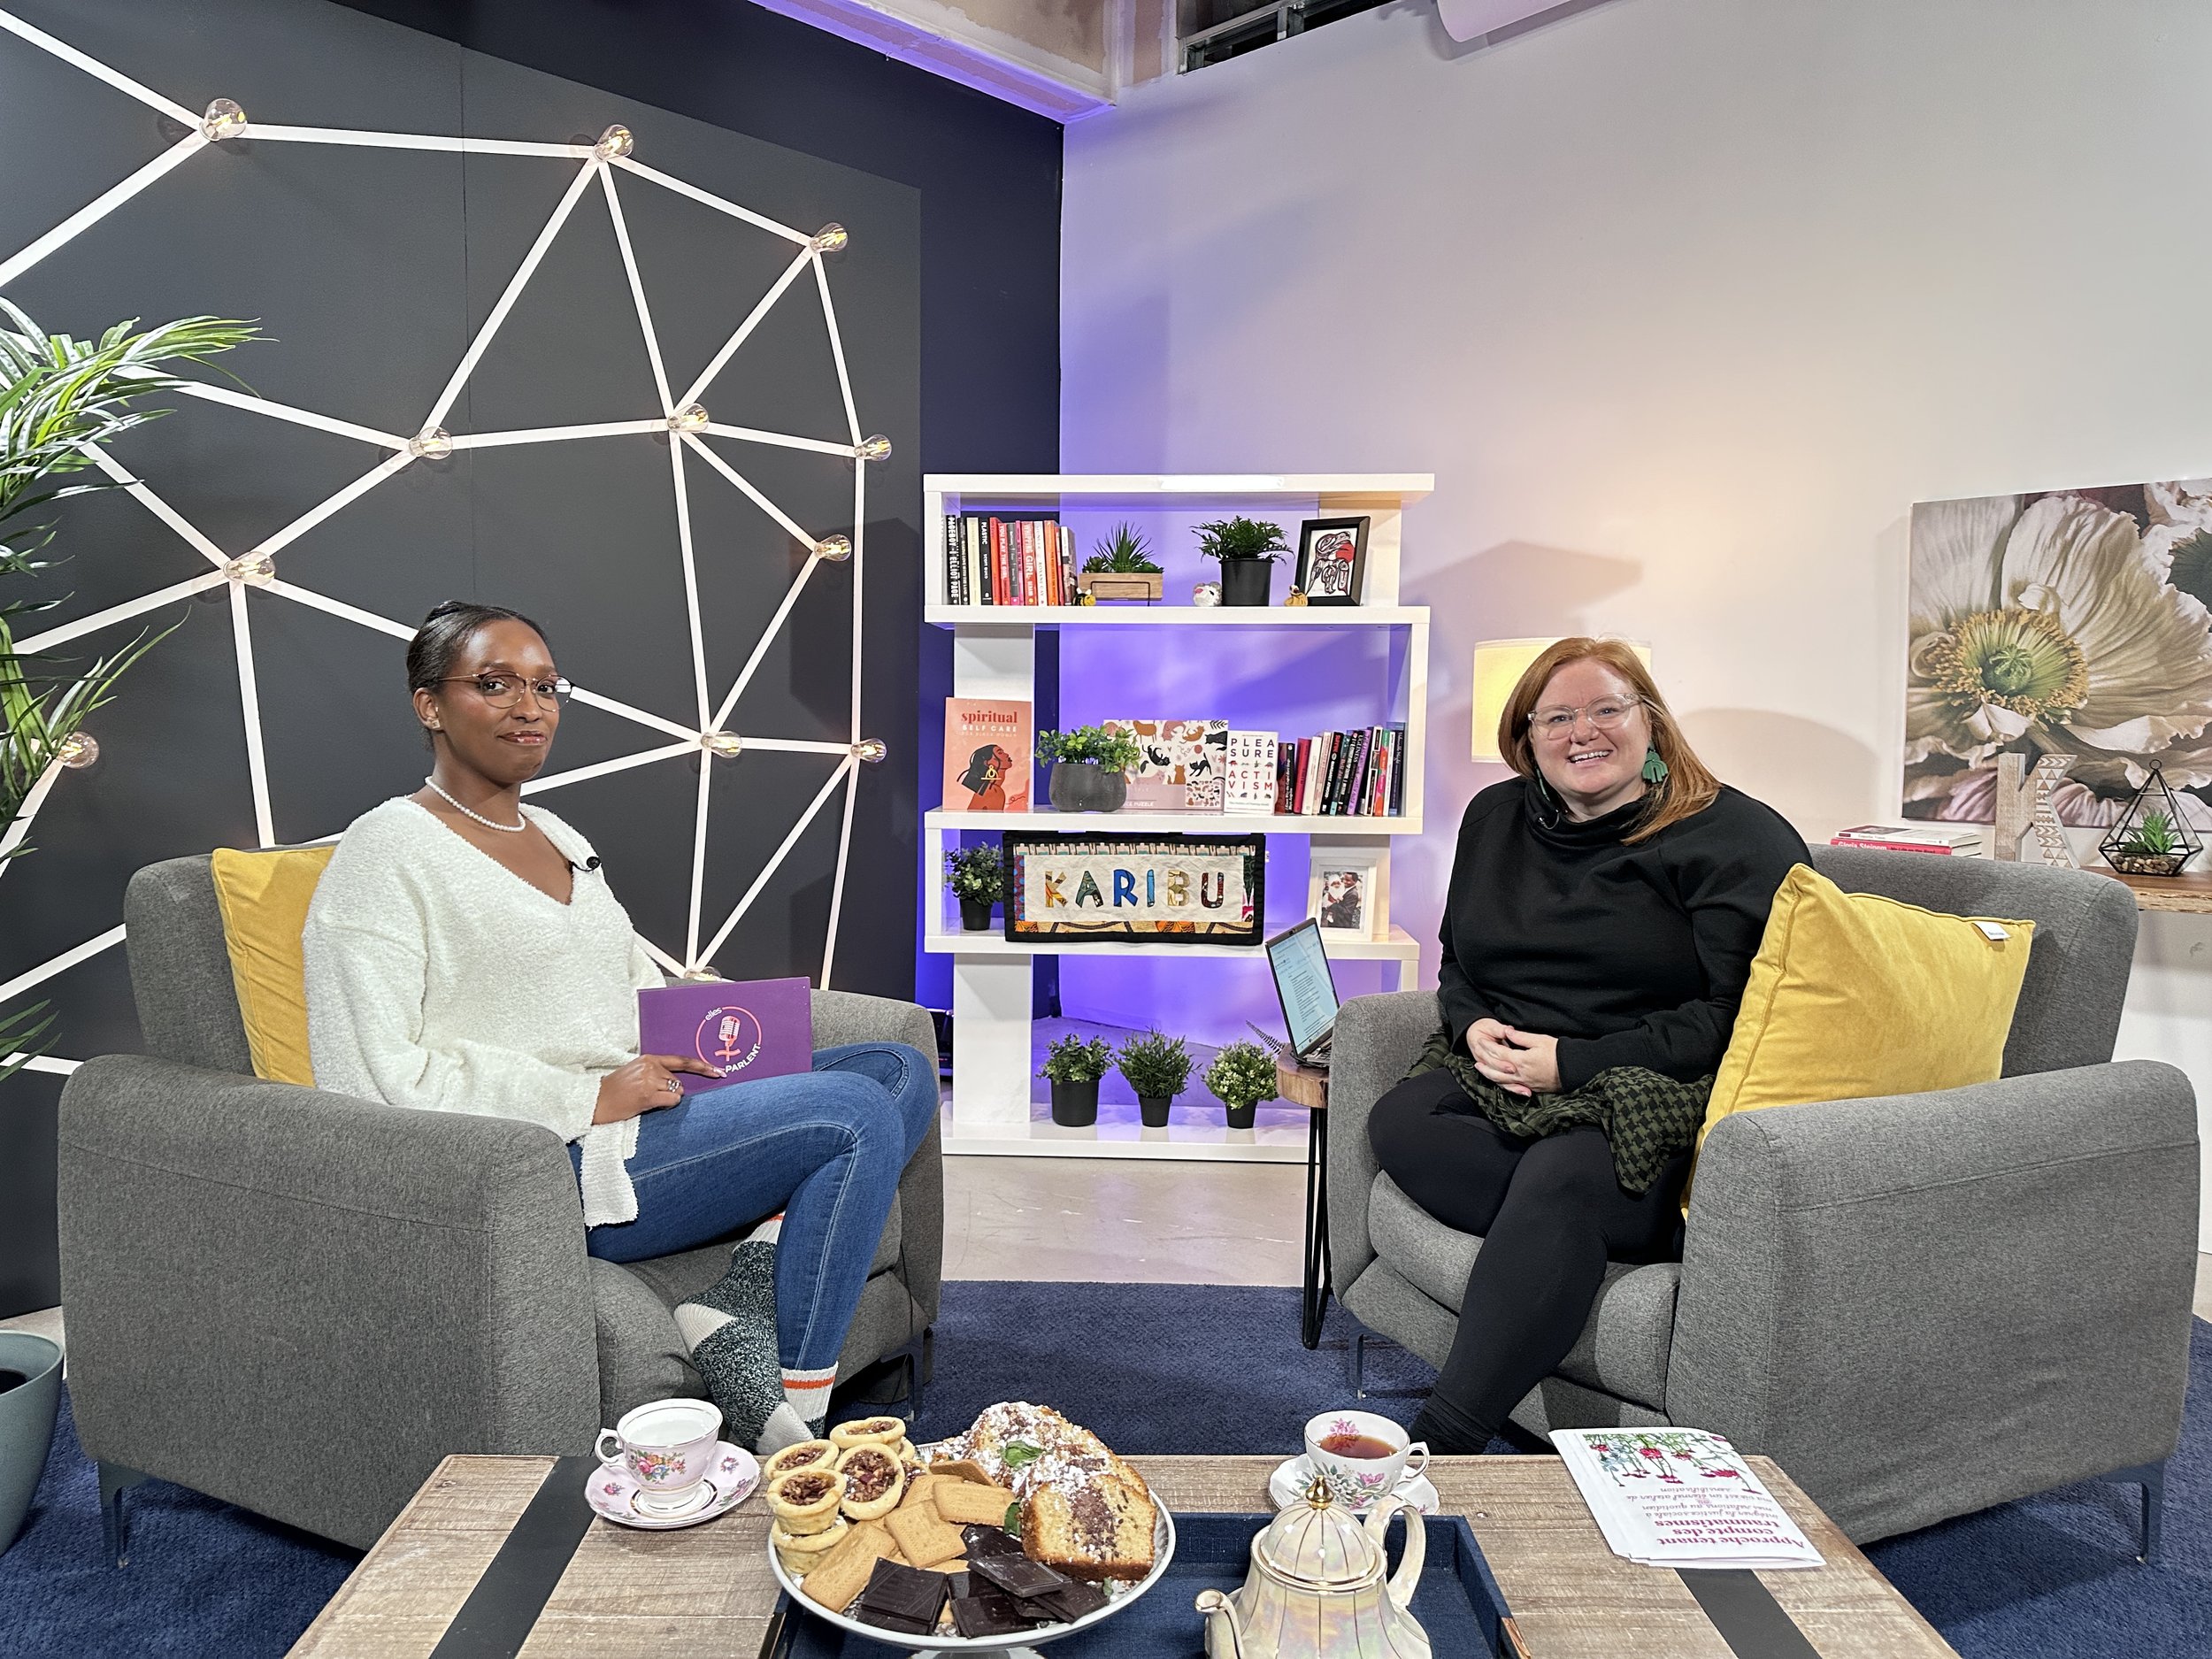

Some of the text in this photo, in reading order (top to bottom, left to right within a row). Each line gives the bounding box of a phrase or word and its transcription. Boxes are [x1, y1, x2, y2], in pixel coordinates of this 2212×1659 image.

[1023, 523, 1033, 554] WHIPPING
[949, 557, 958, 580] ELLIOT
[961, 710, 1018, 724] spiritual
[1354, 734, 1363, 763] UGLINESS
[1045, 869, 1225, 909] KARIBU
[704, 1007, 723, 1021] elles
[725, 1043, 762, 1073] PARLENT
[1641, 1502, 1687, 1511] quotidien
[1654, 1519, 1781, 1528] traumatismes
[1707, 1526, 1774, 1535] compte
[1719, 1536, 1804, 1548] Approche
